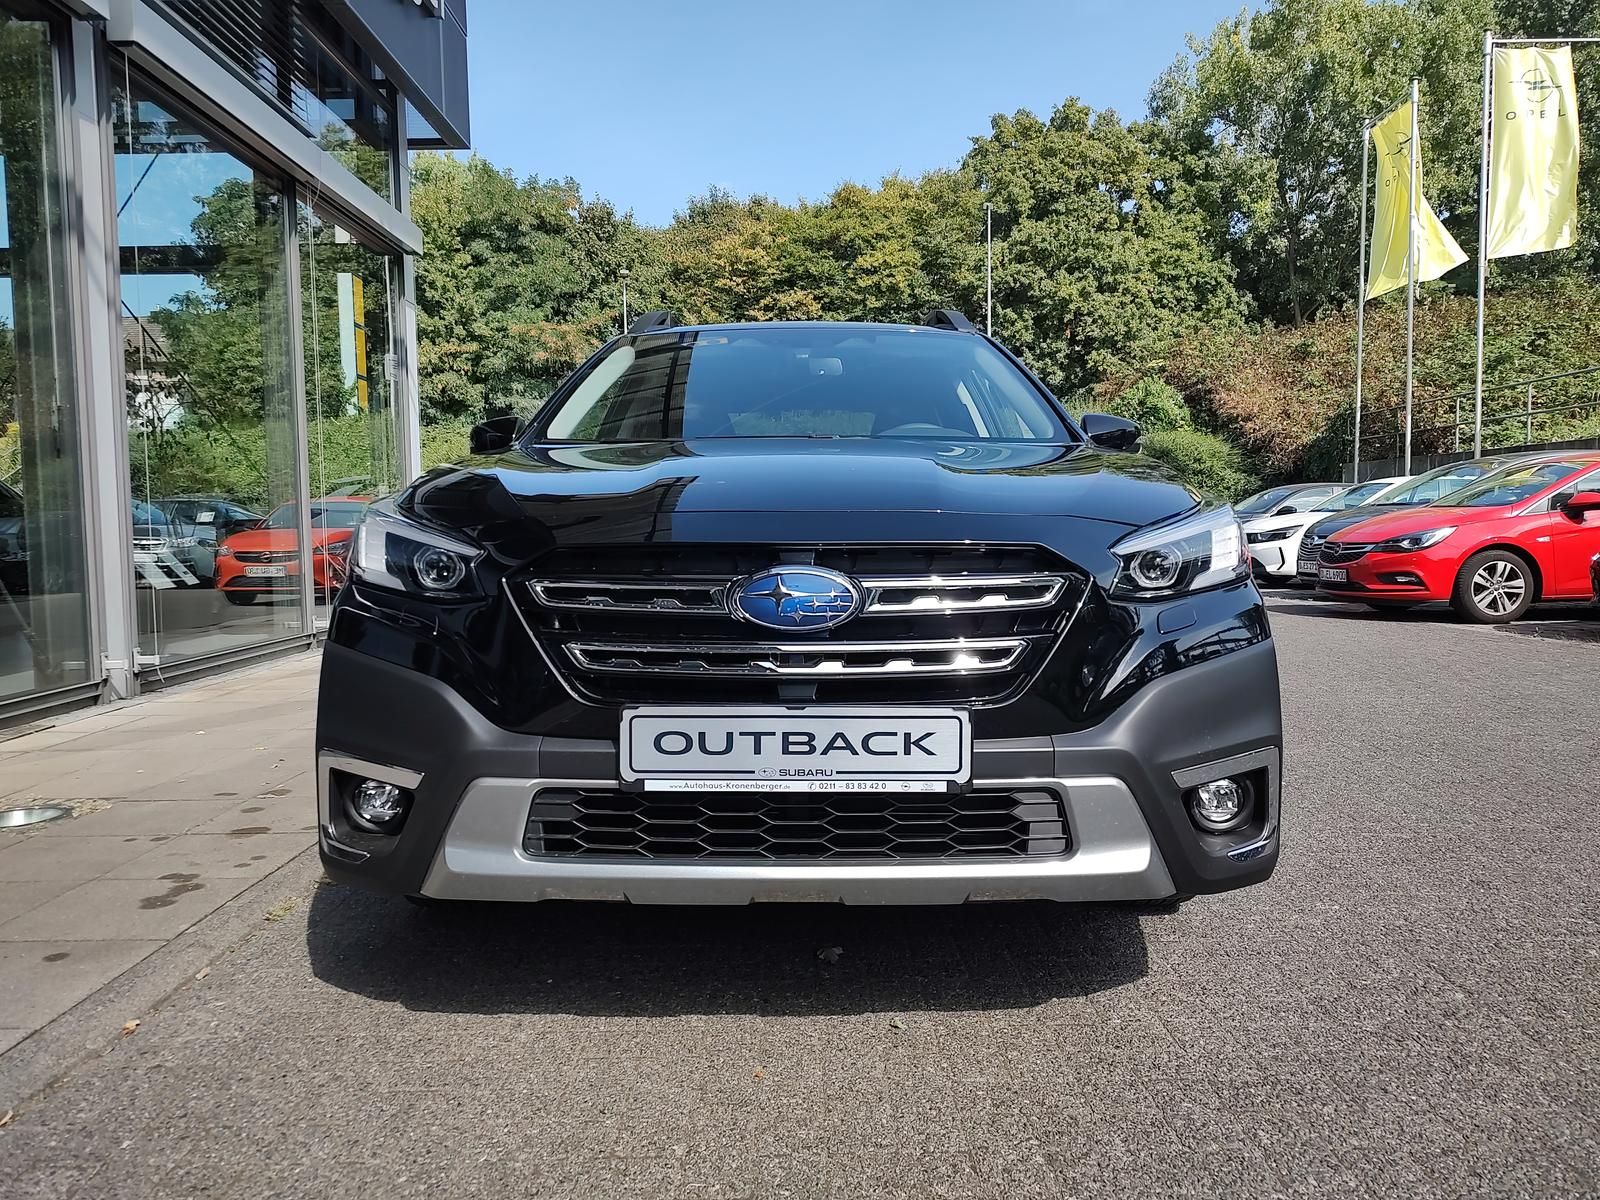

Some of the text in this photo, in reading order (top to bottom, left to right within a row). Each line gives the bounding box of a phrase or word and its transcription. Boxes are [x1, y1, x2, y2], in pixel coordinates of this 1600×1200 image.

[653, 730, 937, 756] OUTBACK
[778, 768, 834, 777] SUBARU
[669, 782, 791, 791] www.Autohaus-Kronenberger.de
